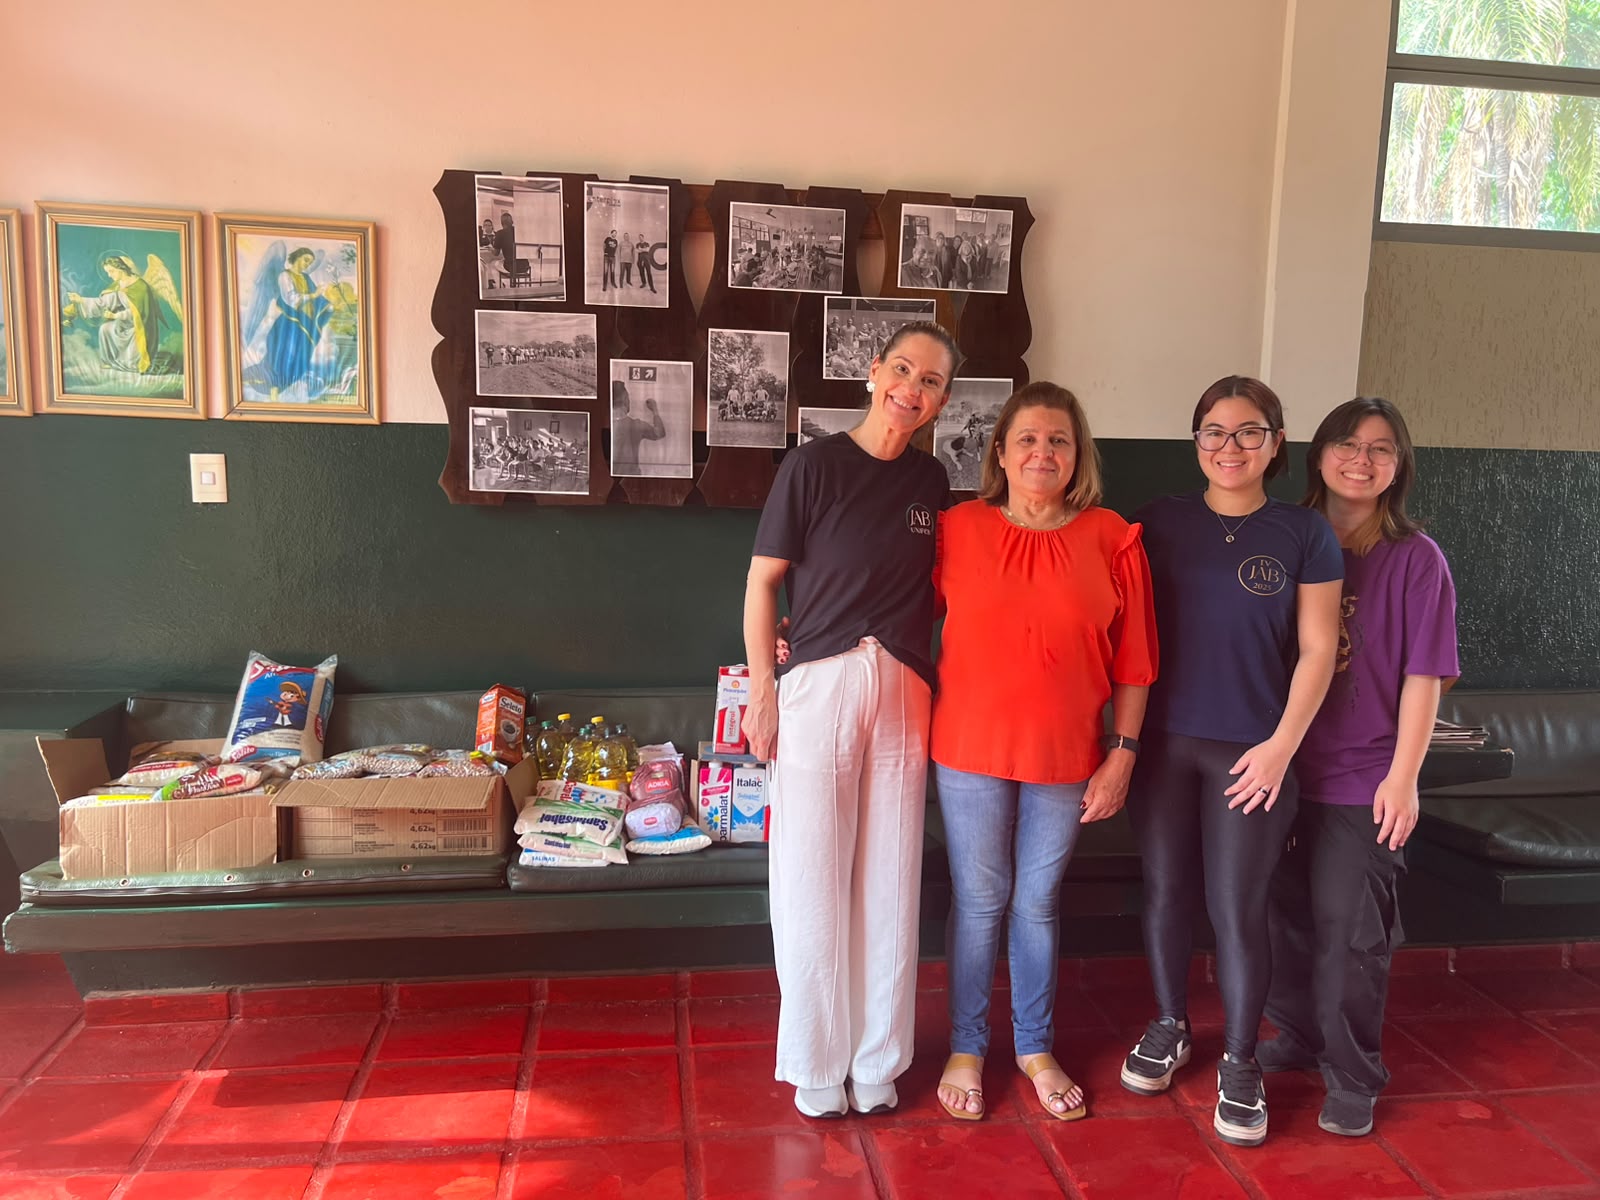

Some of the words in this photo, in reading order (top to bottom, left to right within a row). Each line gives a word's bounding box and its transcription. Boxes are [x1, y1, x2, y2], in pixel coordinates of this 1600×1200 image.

[910, 510, 931, 526] JAB
[1248, 565, 1279, 583] JAB
[1253, 583, 1271, 591] 2025
[500, 697, 522, 714] Seleto
[736, 777, 763, 788] Italac
